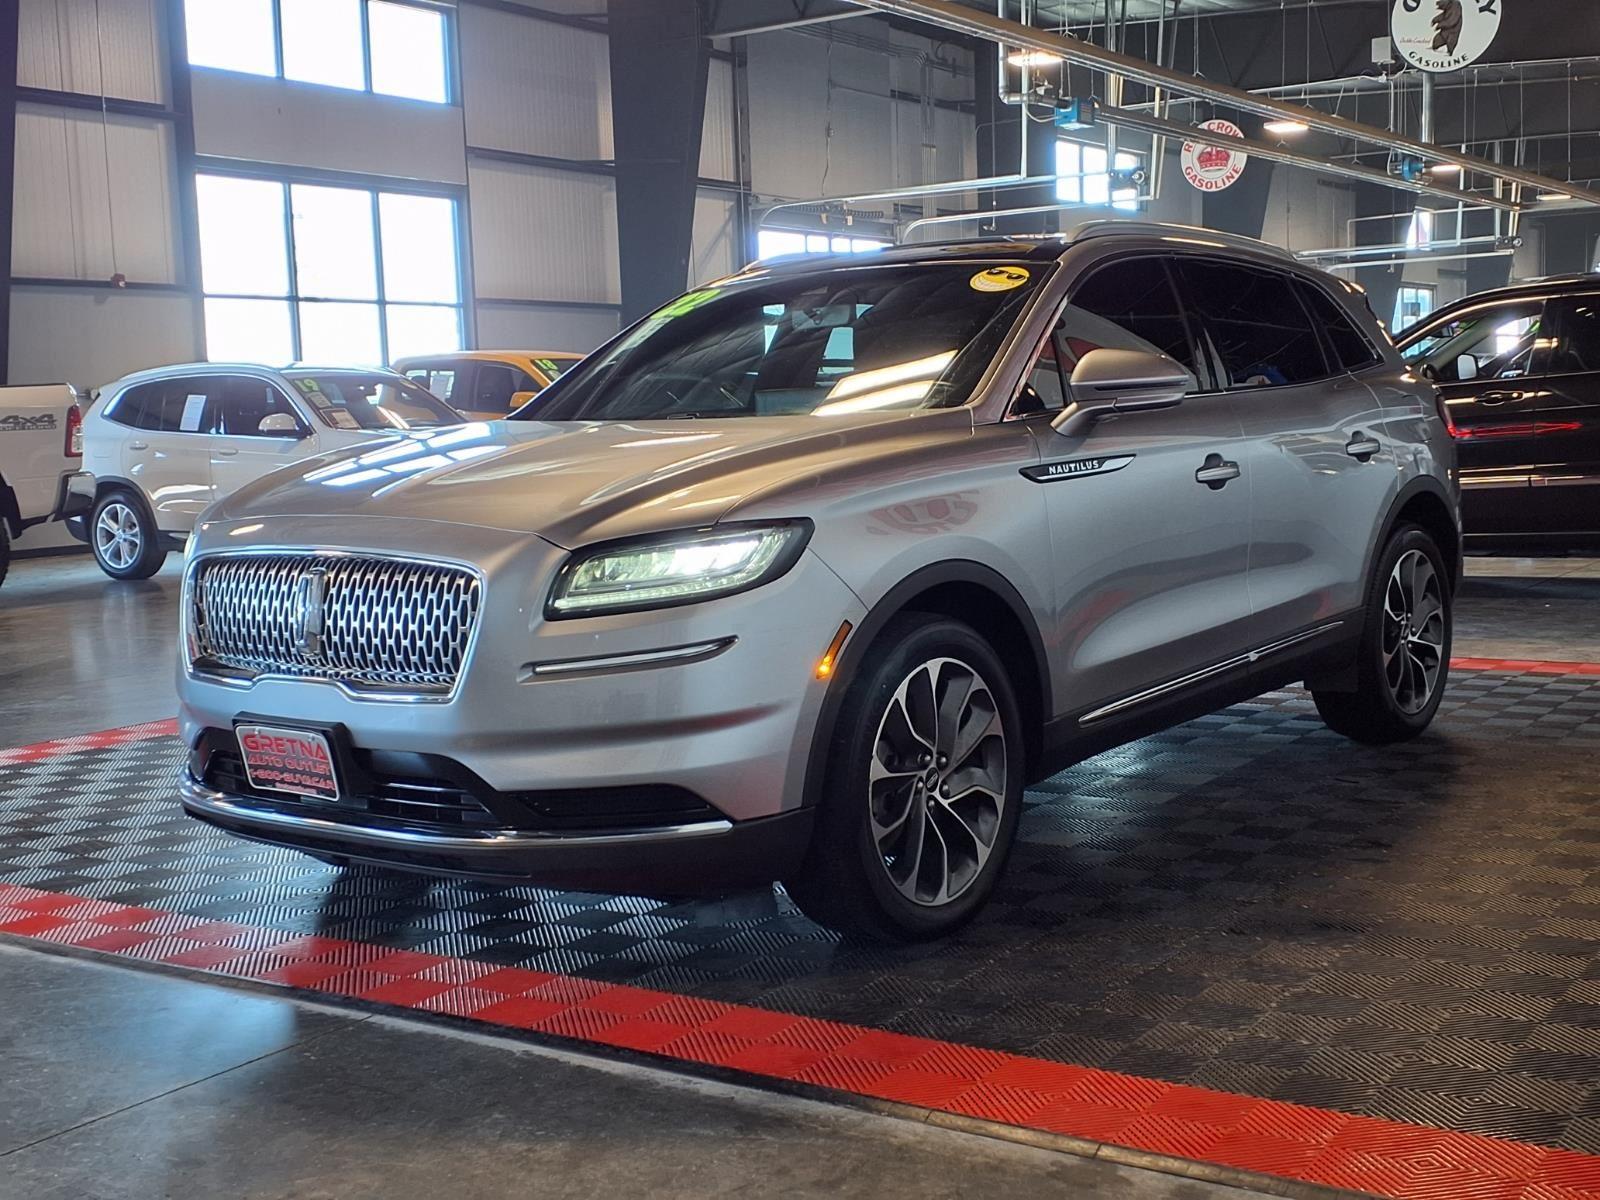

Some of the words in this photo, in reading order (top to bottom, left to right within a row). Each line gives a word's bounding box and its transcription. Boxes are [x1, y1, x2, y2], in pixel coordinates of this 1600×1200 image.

[1408, 51, 1469, 68] GASOLINE
[1184, 163, 1242, 190] GASOLINE
[294, 378, 319, 392] 19
[1048, 460, 1100, 475] NAUTILUS
[243, 732, 329, 763] GRETNA
[247, 754, 284, 768] AUTO
[285, 757, 331, 776] OUTLET
